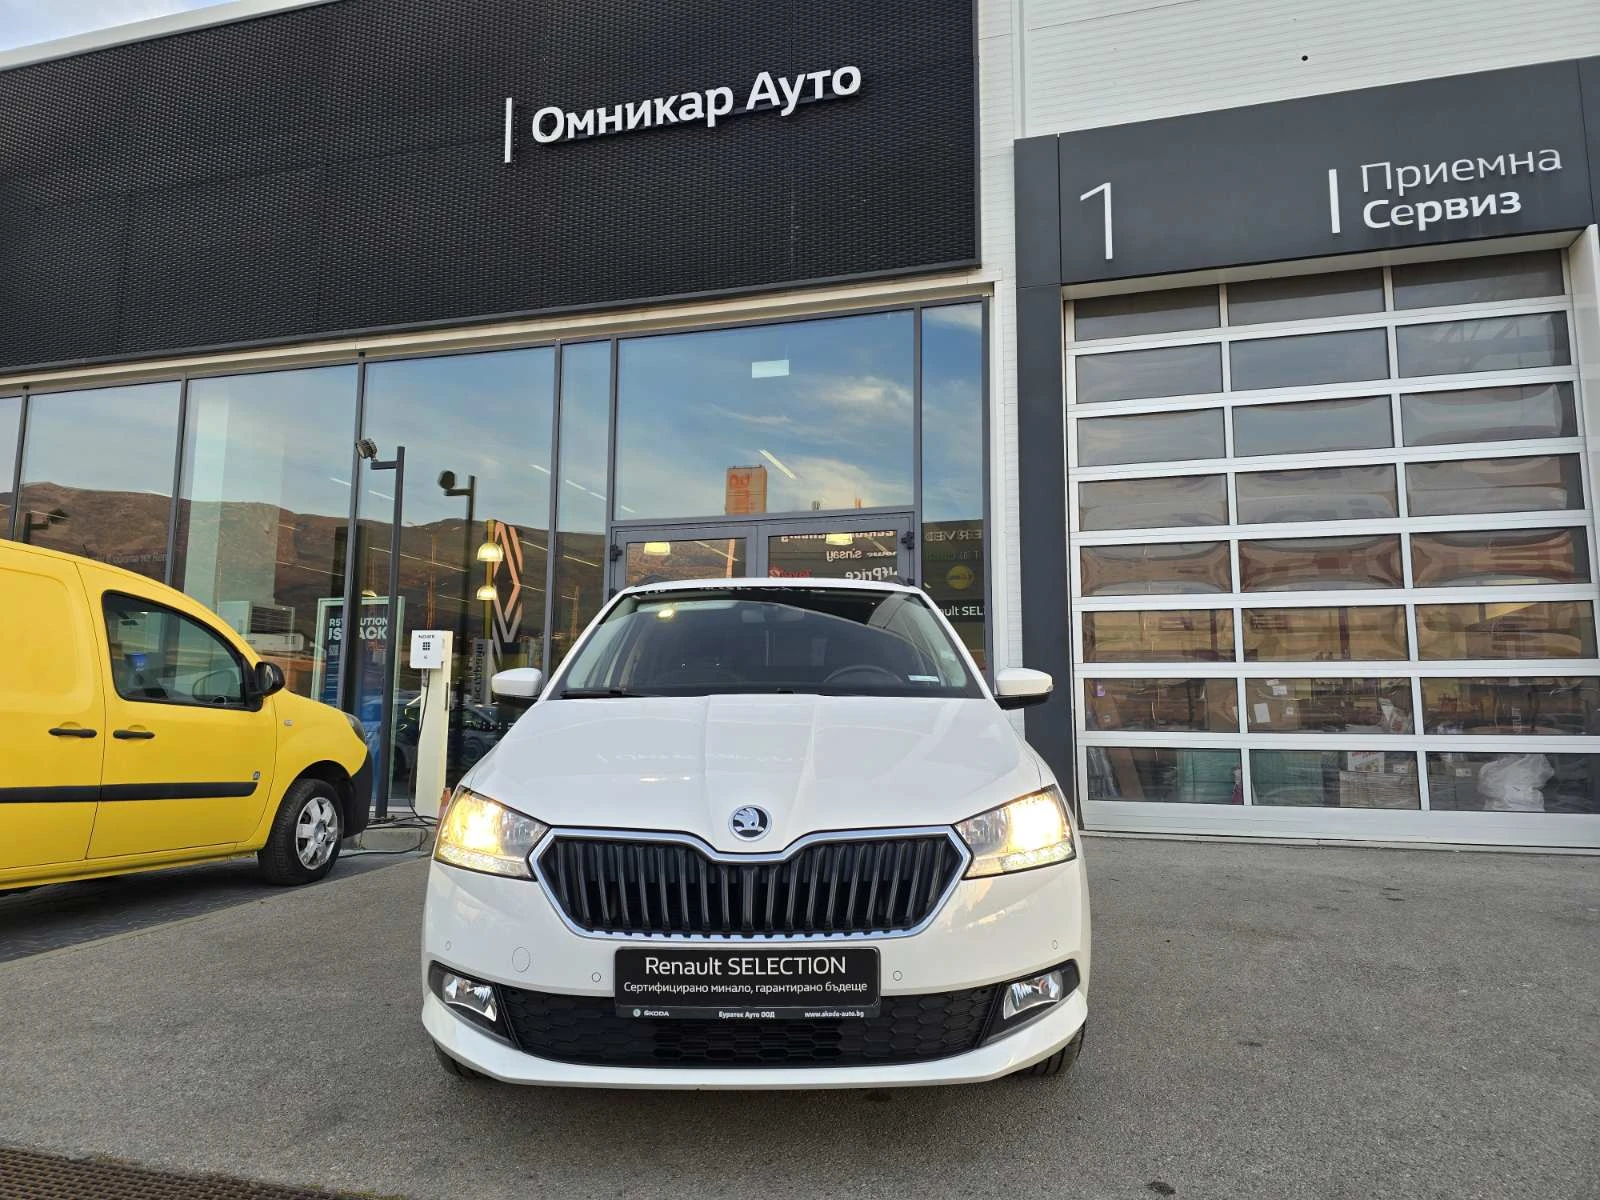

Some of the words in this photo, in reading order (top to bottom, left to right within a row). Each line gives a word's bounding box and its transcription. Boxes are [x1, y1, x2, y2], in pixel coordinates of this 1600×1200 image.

[531, 84, 734, 145] Омникар
[745, 65, 863, 117] Ауто
[1359, 148, 1564, 197] Приемна
[1078, 182, 1115, 261] 1
[1361, 191, 1523, 232] Сервиз
[358, 626, 388, 641] ACK
[645, 957, 723, 976] Renault
[727, 955, 847, 976] SELECTION
[623, 981, 710, 995] Сертифицирано
[710, 983, 754, 995] минало,
[755, 982, 824, 995] гарантирано
[824, 981, 869, 994] бъдеще
[760, 1010, 776, 1018] ООД
